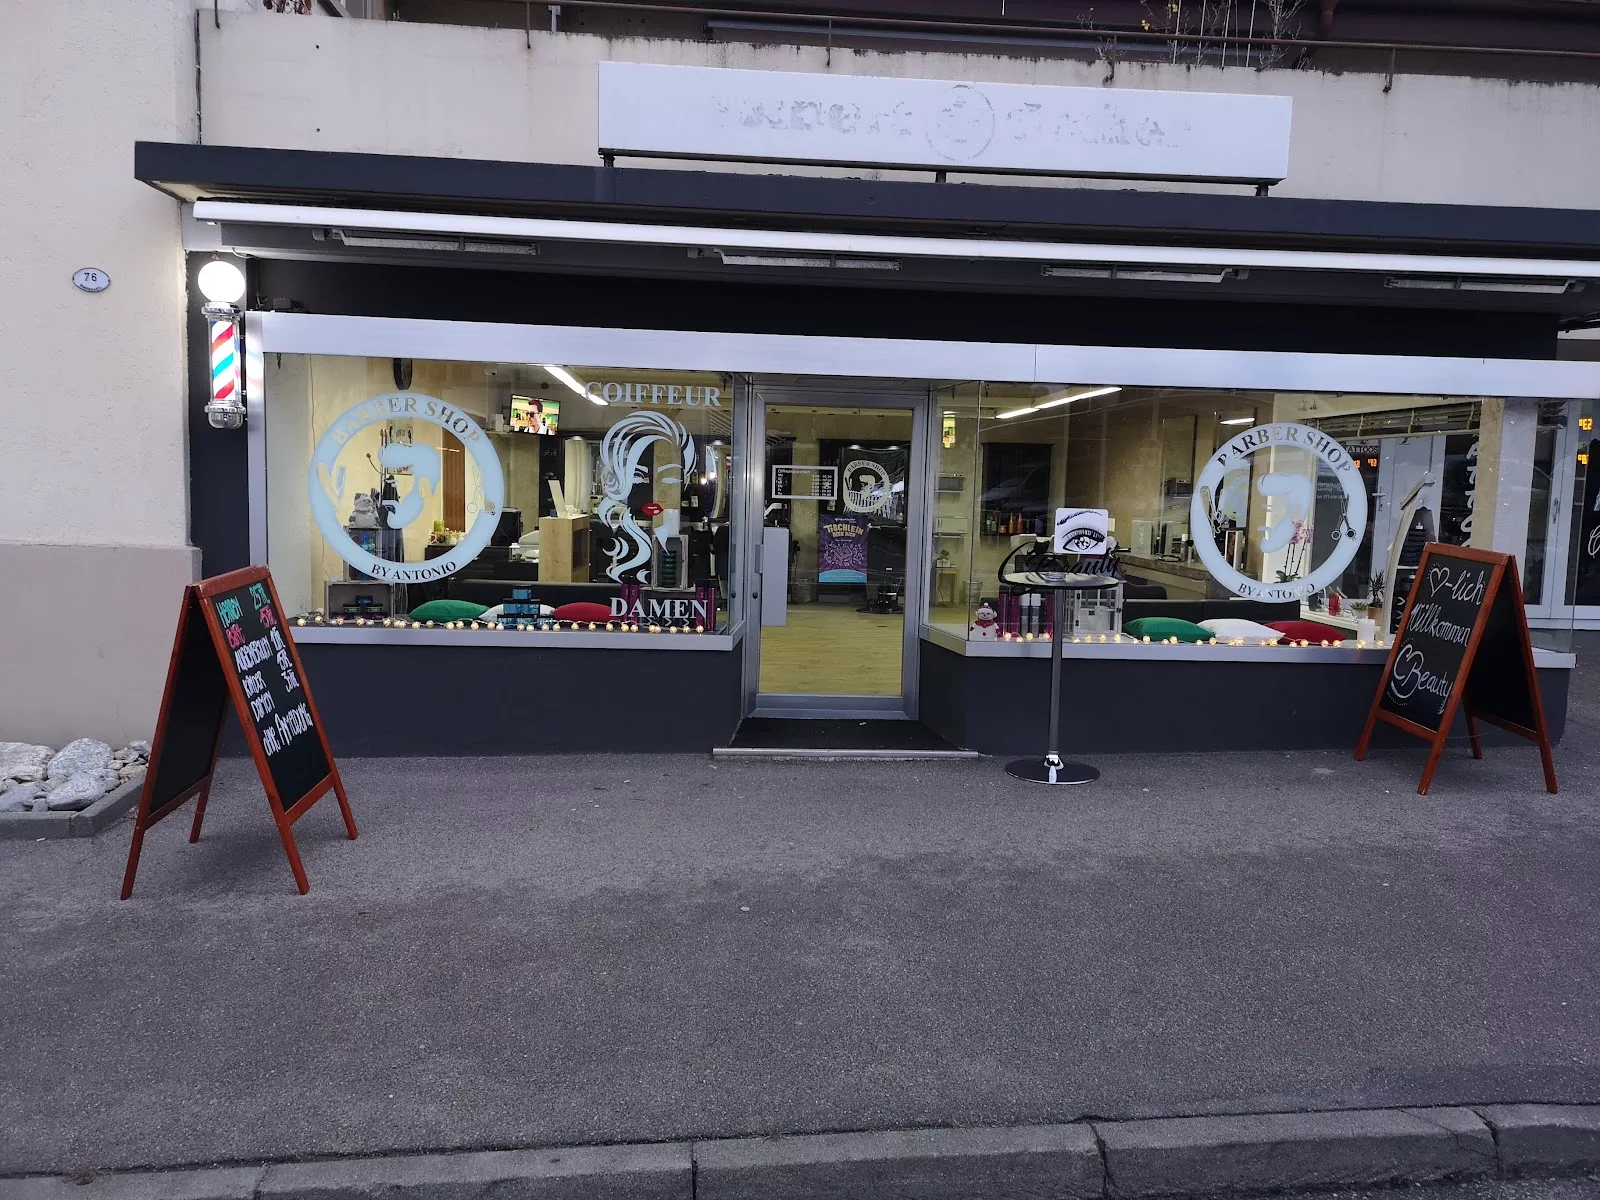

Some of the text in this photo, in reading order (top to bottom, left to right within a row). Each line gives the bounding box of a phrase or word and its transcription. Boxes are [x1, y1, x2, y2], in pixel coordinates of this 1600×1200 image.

[84, 272, 97, 282] 76
[585, 381, 722, 407] COIFFEUR
[331, 397, 480, 445] BARBER SHOP
[1217, 425, 1352, 472] BARBER SHOP
[823, 523, 864, 536] TISCHLEIN
[371, 561, 456, 580] BY ANTONIO
[1237, 582, 1315, 599] BY ANTONIO
[609, 597, 708, 619] DAMEN
[1406, 602, 1472, 648] Willkommen
